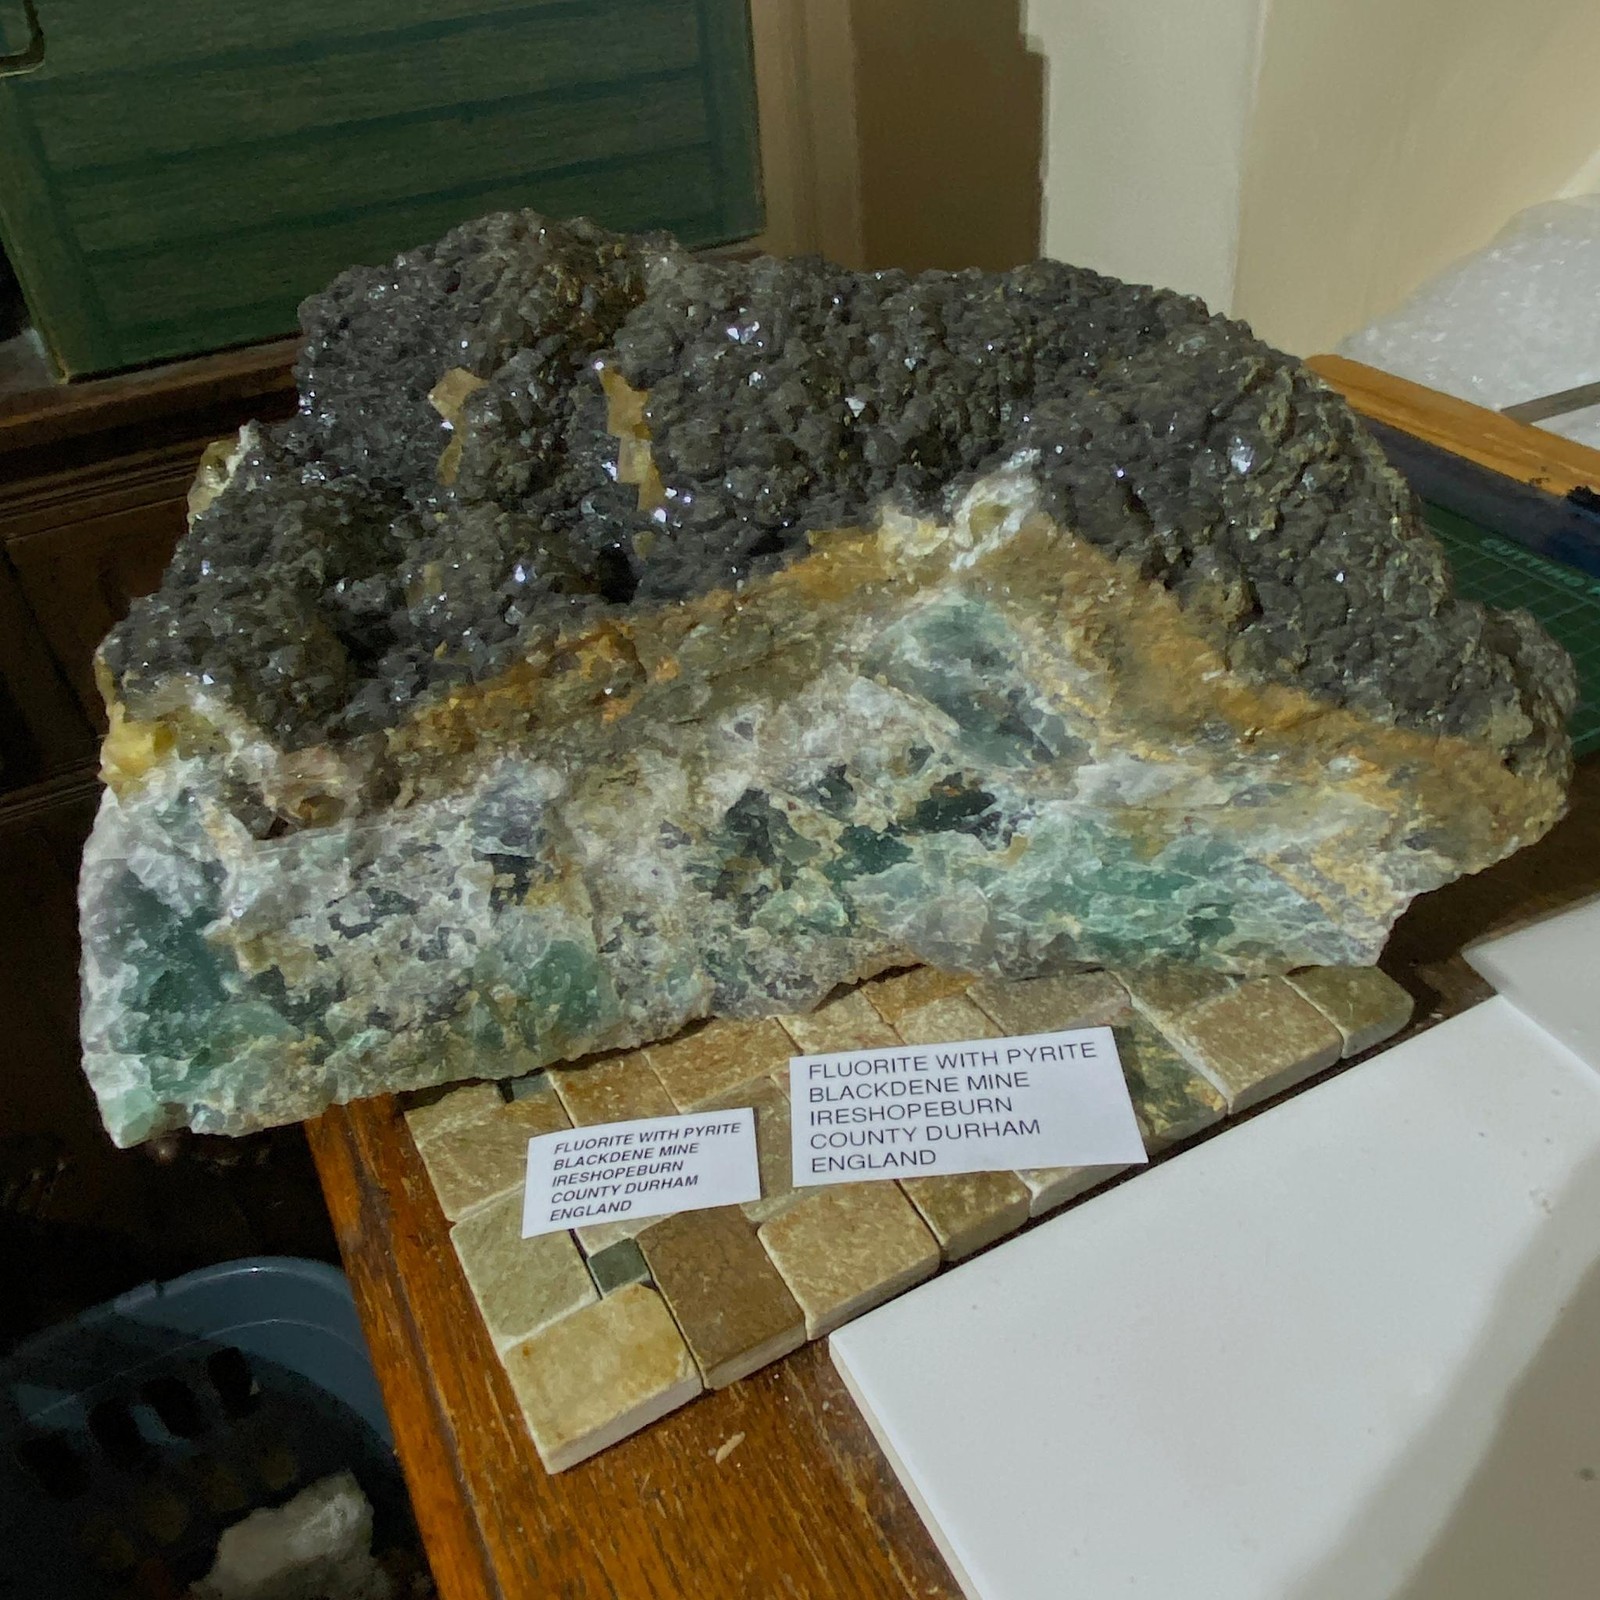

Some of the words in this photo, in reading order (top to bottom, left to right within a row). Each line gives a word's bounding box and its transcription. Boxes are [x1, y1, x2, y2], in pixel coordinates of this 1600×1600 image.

[809, 1056, 929, 1080] FLUORITE
[936, 1051, 999, 1070] WITH
[1007, 1042, 1097, 1065] PYRITE
[809, 1077, 960, 1103] BLACKDENE
[966, 1072, 1030, 1092] MINE
[810, 1097, 1013, 1127] IRESHOPEBURN
[553, 1134, 635, 1155] FLUORITE
[640, 1129, 679, 1144] WITH
[684, 1123, 742, 1139] PYRITE
[810, 1127, 918, 1150] COUNTY
[926, 1119, 1041, 1142] DURHAM
[553, 1148, 655, 1171] BLACKDENE
[659, 1143, 700, 1158] MINE
[811, 1150, 937, 1174] ENGLAND
[552, 1161, 684, 1188] IRESHOPEBURN
[551, 1185, 622, 1204] COUNTY
[625, 1175, 699, 1195] DURHAM
[549, 1200, 632, 1222] ENGLAND
